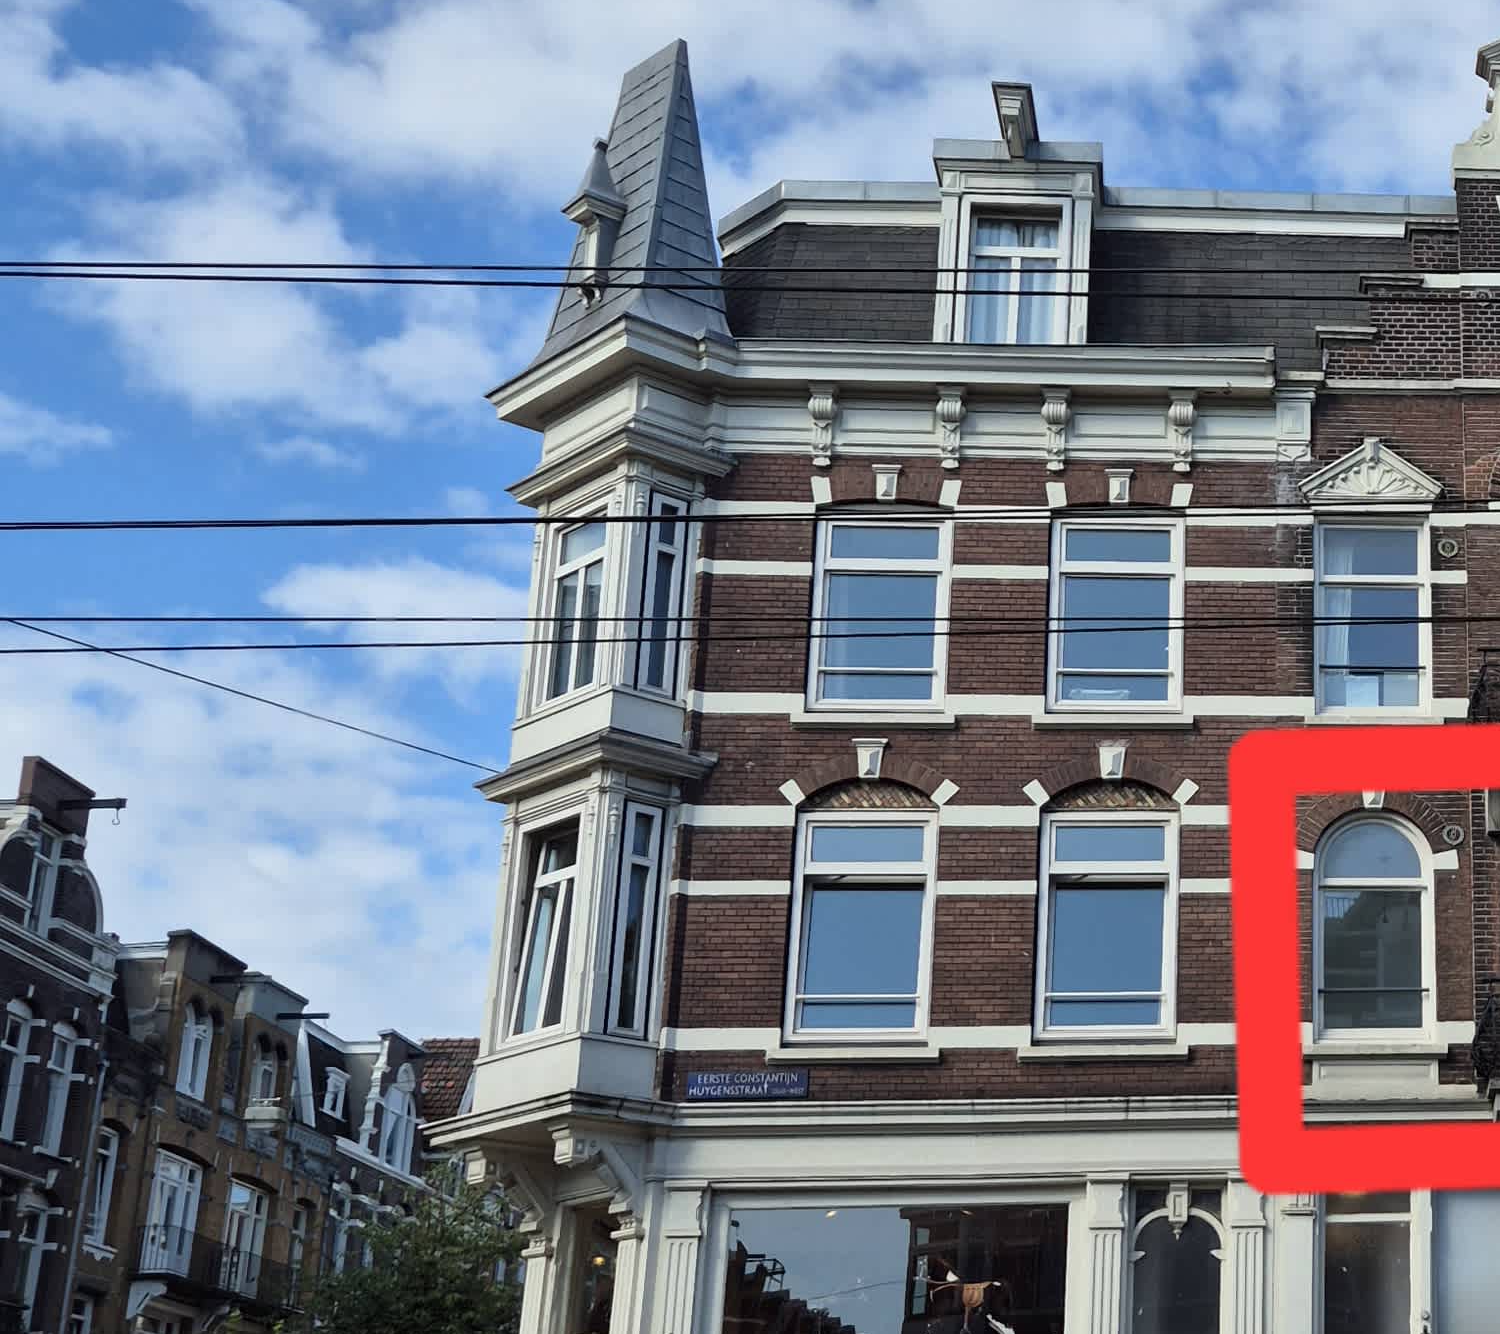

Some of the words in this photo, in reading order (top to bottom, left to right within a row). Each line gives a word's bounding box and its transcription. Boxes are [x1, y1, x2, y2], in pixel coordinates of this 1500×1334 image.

[697, 1073, 730, 1084] EERSTE
[734, 1072, 799, 1085] CONSTANTIJN
[688, 1084, 769, 1096] HUYGENSSTRAAT
